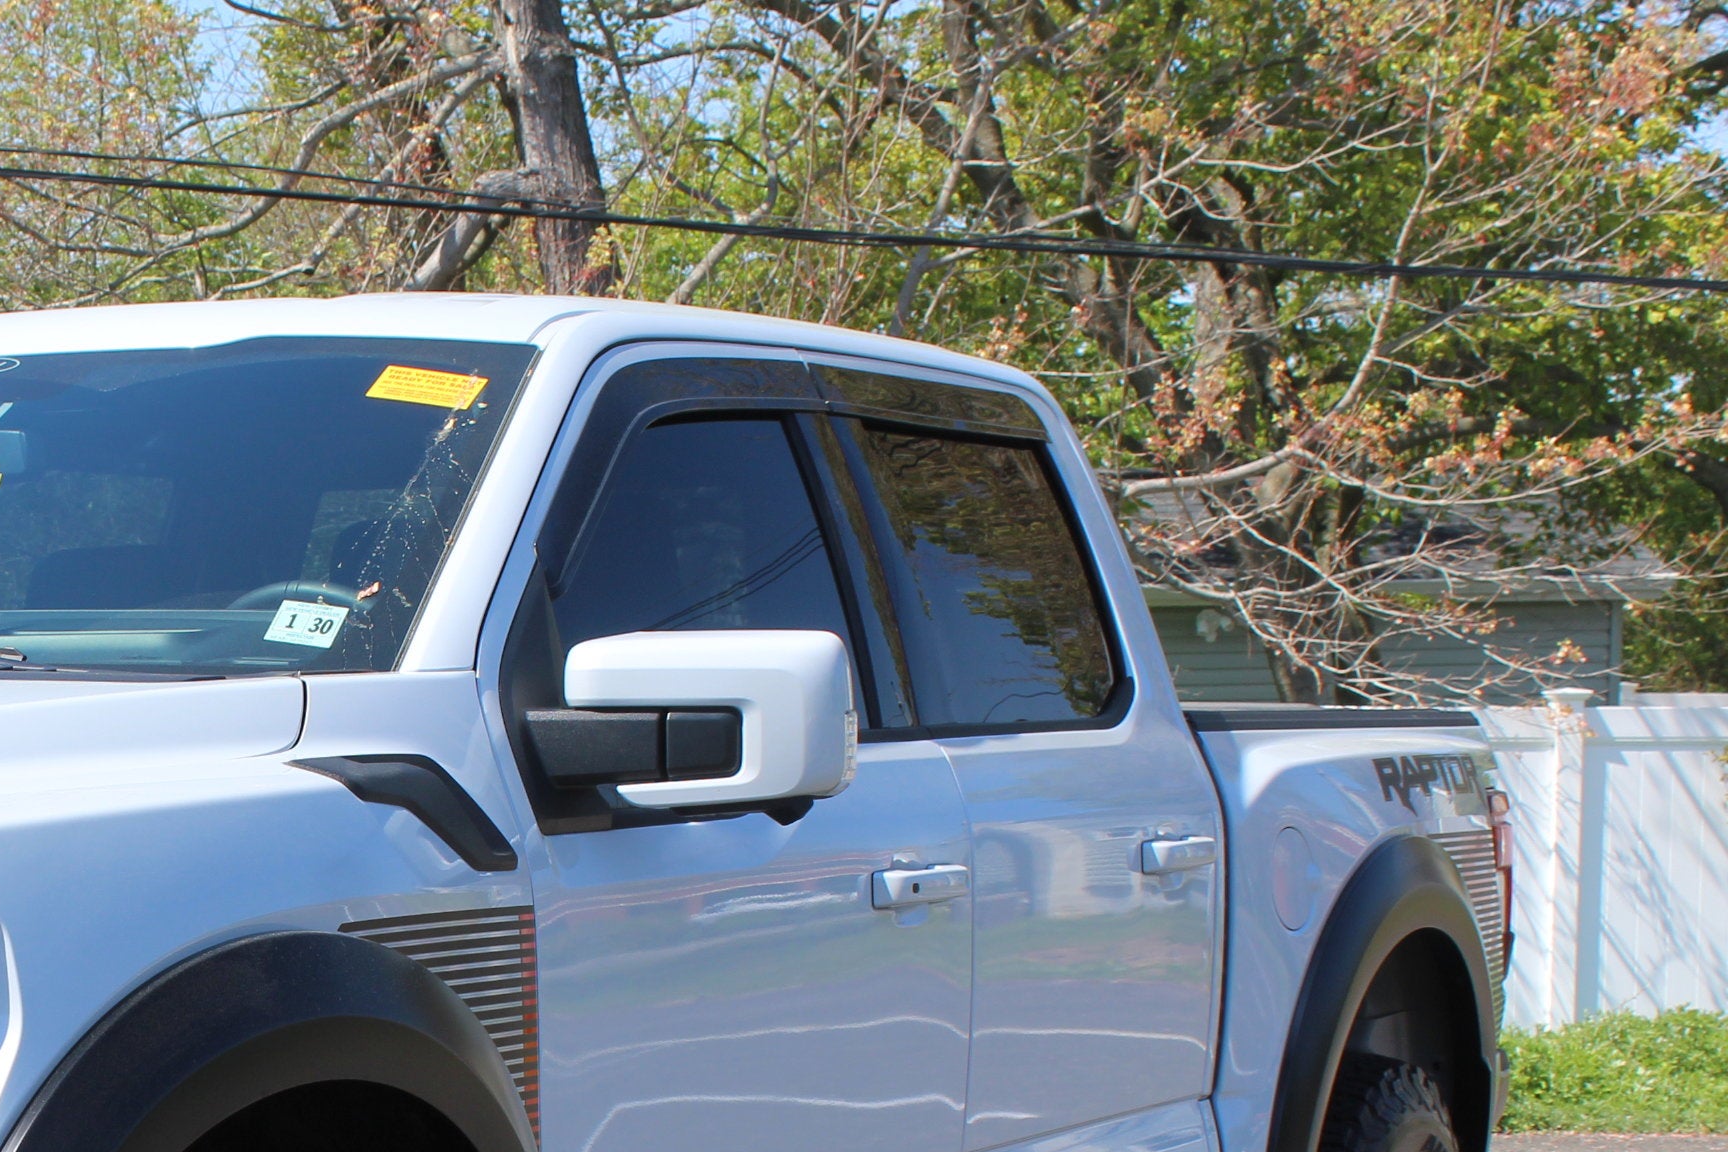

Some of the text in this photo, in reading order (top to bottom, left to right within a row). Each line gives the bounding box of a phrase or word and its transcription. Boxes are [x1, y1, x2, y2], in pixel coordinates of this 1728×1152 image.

[461, 378, 485, 387] NT
[285, 613, 334, 634] 1 30
[1372, 753, 1486, 816] RAPTOR
